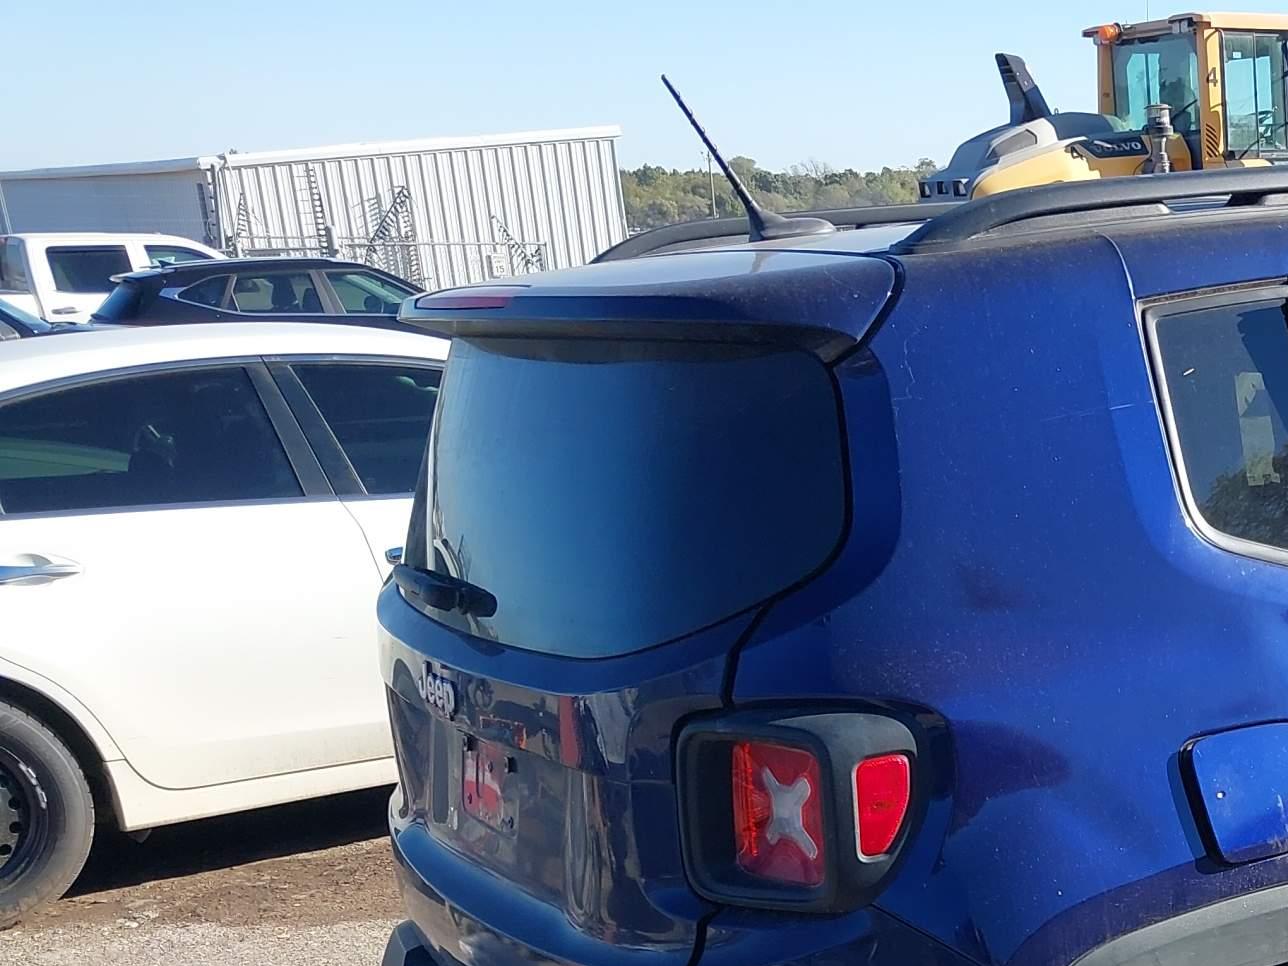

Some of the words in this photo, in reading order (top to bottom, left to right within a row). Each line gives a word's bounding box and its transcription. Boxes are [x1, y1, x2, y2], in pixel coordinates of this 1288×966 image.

[1207, 67, 1218, 87] 4
[495, 265, 505, 273] 15
[418, 661, 455, 719] Jeep
